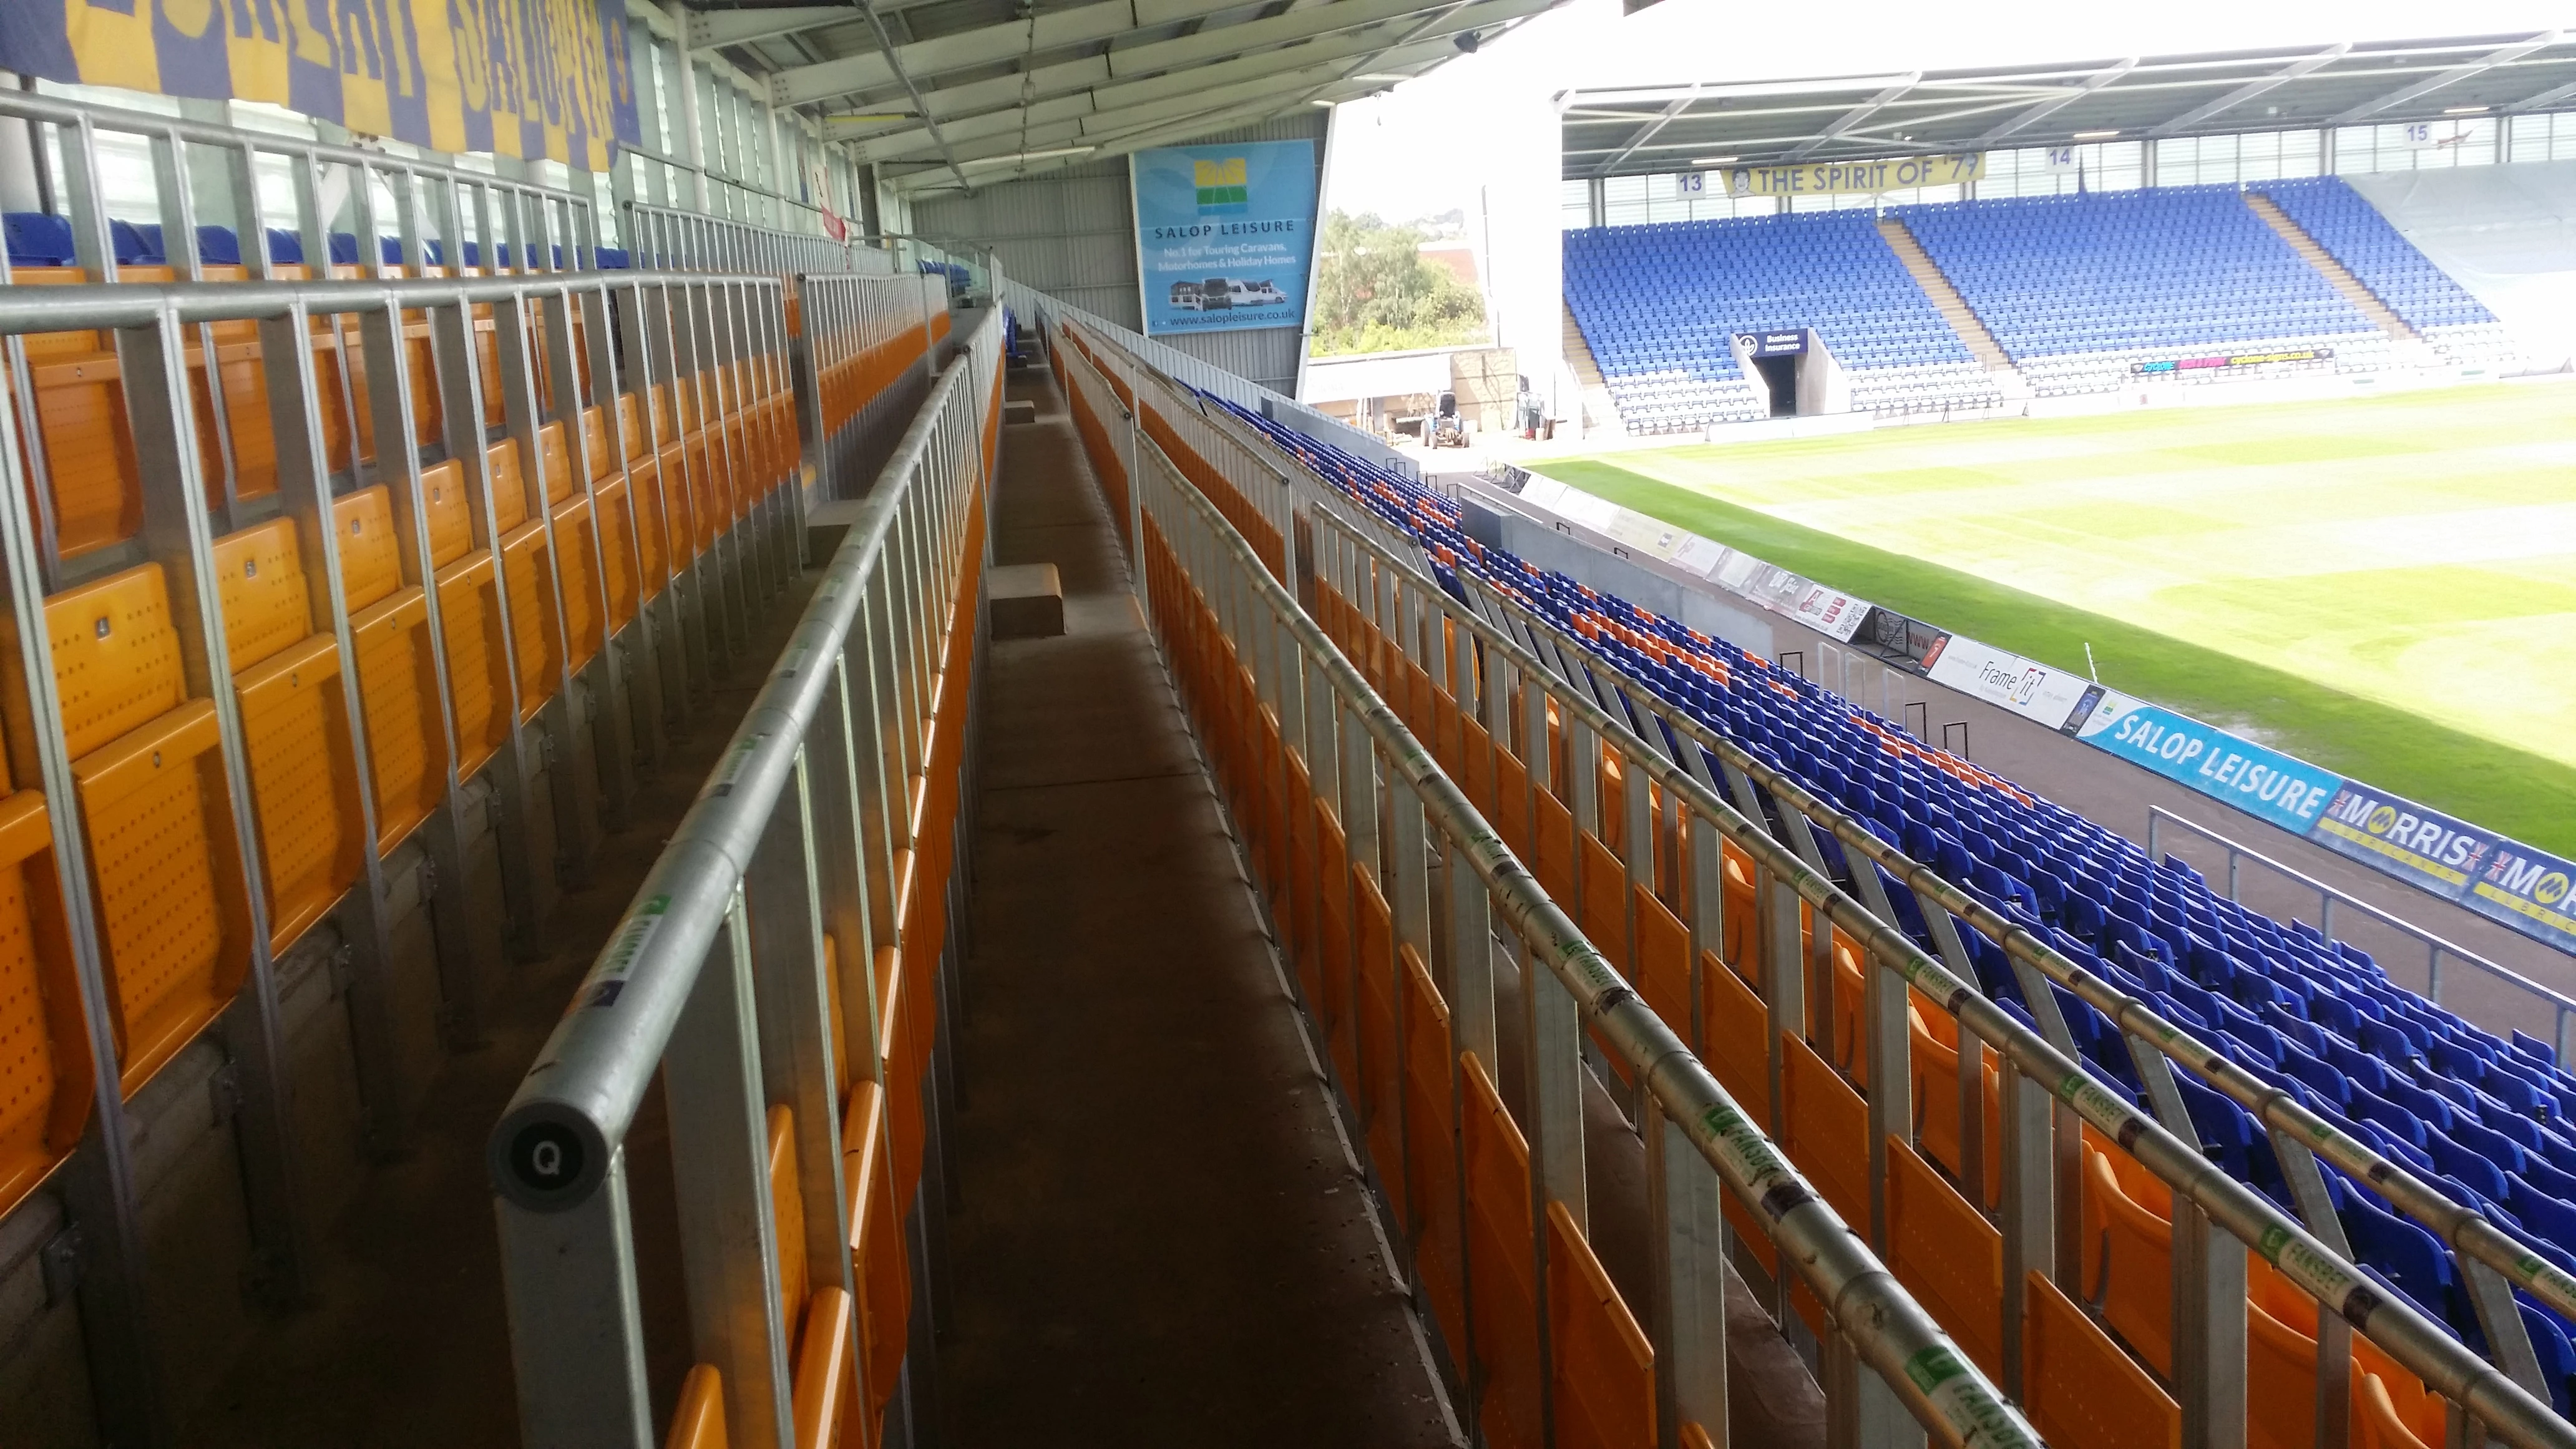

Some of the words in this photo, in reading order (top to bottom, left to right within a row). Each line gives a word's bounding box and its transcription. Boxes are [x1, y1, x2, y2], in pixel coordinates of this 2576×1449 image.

[2408, 125, 2427, 141] 15
[2049, 148, 2070, 165] 14
[1679, 174, 1702, 192] 13
[1759, 169, 1803, 192] THE
[1813, 165, 1888, 190] SPIRIT
[1896, 160, 1933, 184] OF
[1155, 225, 1211, 238] SALOP
[1221, 220, 1294, 235] LEISURE
[1164, 248, 1186, 258] No.1
[1188, 246, 1202, 256] for
[1205, 245, 1240, 255] Touring
[1241, 243, 1287, 253] Caravans,
[1158, 260, 1217, 271] Motorhomes
[1218, 259, 1227, 268] &
[1227, 256, 1262, 267] Holiday
[1264, 255, 1296, 265] Homes
[1170, 308, 1295, 326] www.salopleisure.co.uk
[1765, 343, 1800, 352] Insurance
[1767, 334, 1798, 343] Business
[1979, 661, 2017, 690] Frame
[2019, 675, 2036, 696] it
[2114, 715, 2203, 765] SALOP
[2198, 747, 2328, 819] LEISURE
[532, 1140, 560, 1175] Q
